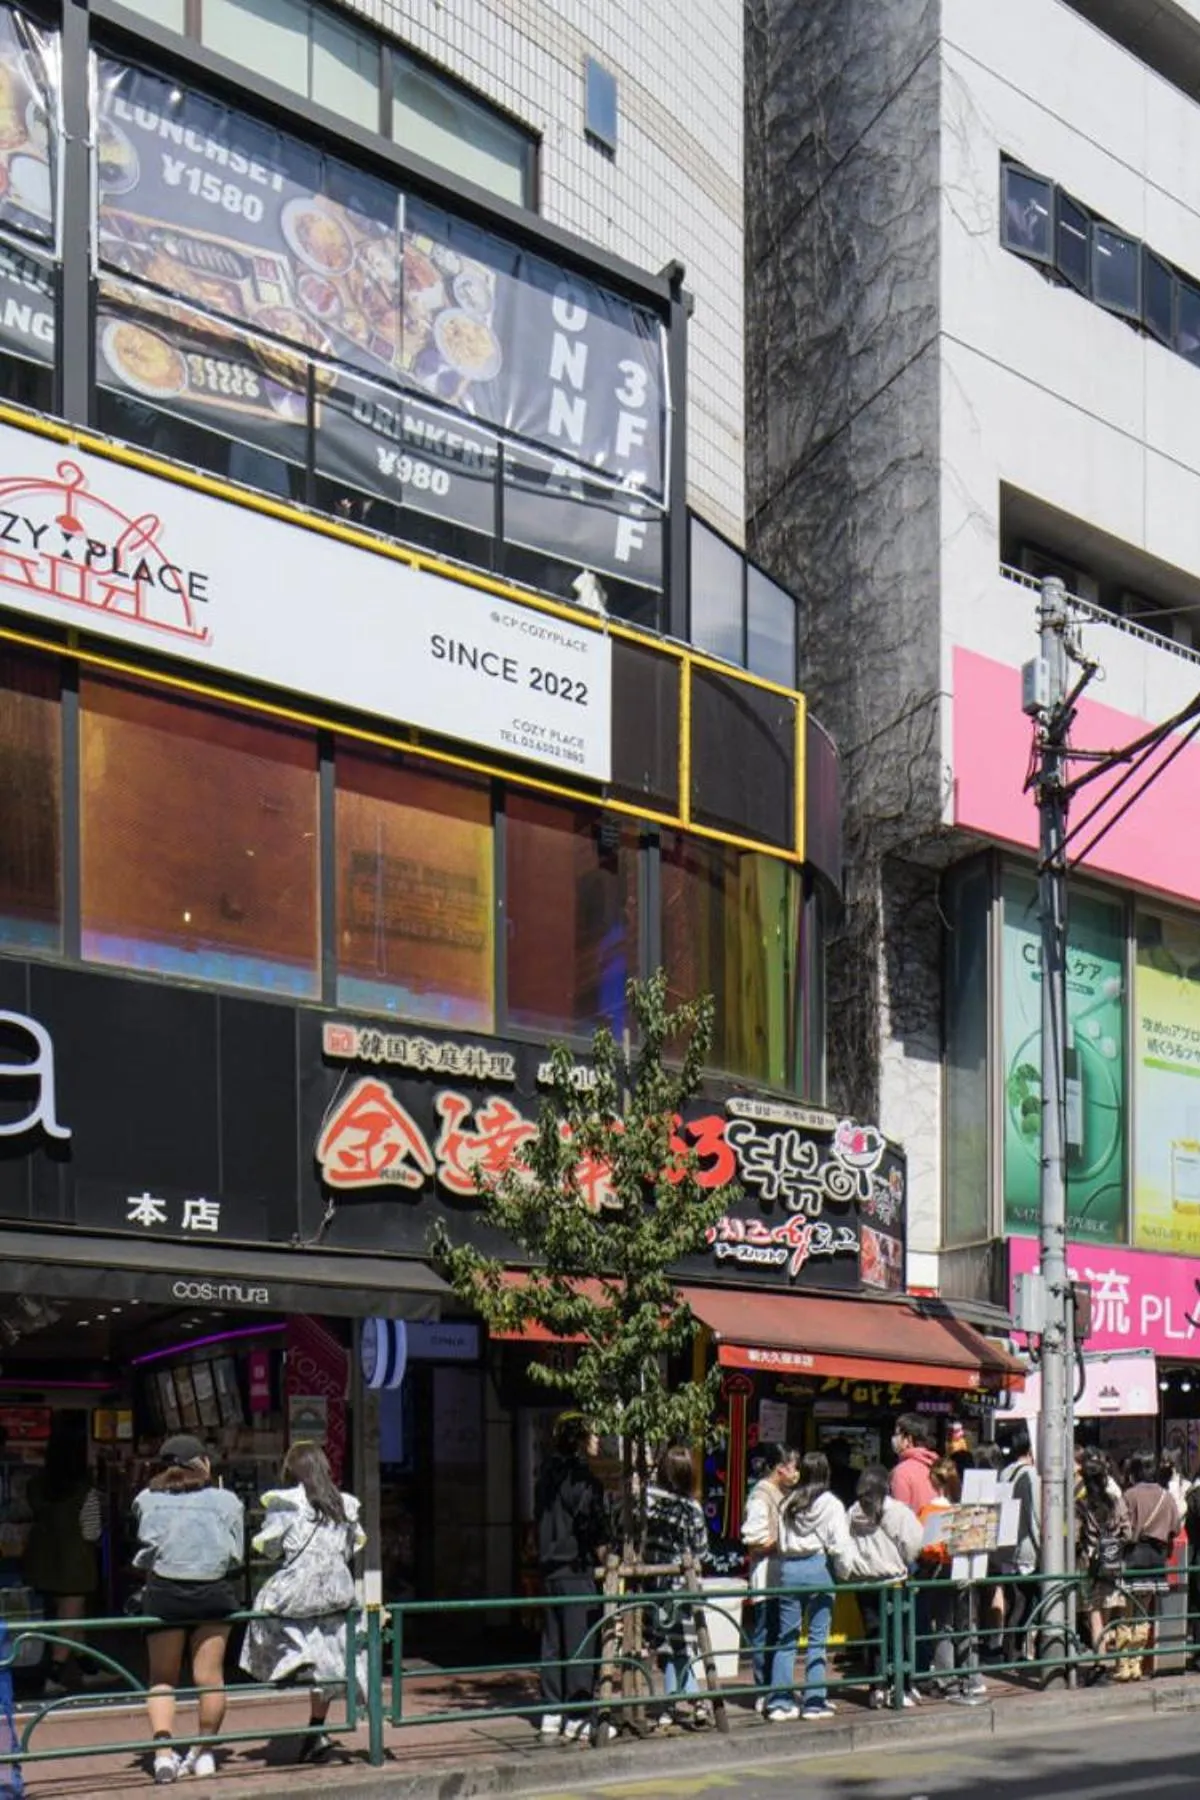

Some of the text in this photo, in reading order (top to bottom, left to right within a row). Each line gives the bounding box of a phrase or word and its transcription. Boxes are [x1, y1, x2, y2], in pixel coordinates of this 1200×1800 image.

[112, 97, 290, 192] LUNCHSET
[161, 153, 264, 224] ¥1580
[0, 297, 56, 345] NG
[376, 447, 450, 497] ¥980
[86, 538, 209, 602] PLACE
[430, 634, 588, 706] SINCE 2022
[512, 718, 585, 750] COZY PLACE
[1022, 942, 1102, 980] Cケア
[359, 1028, 516, 1081] 韓国家庭料理
[127, 1193, 220, 1232] 本店
[172, 1280, 270, 1304] cos:mura
